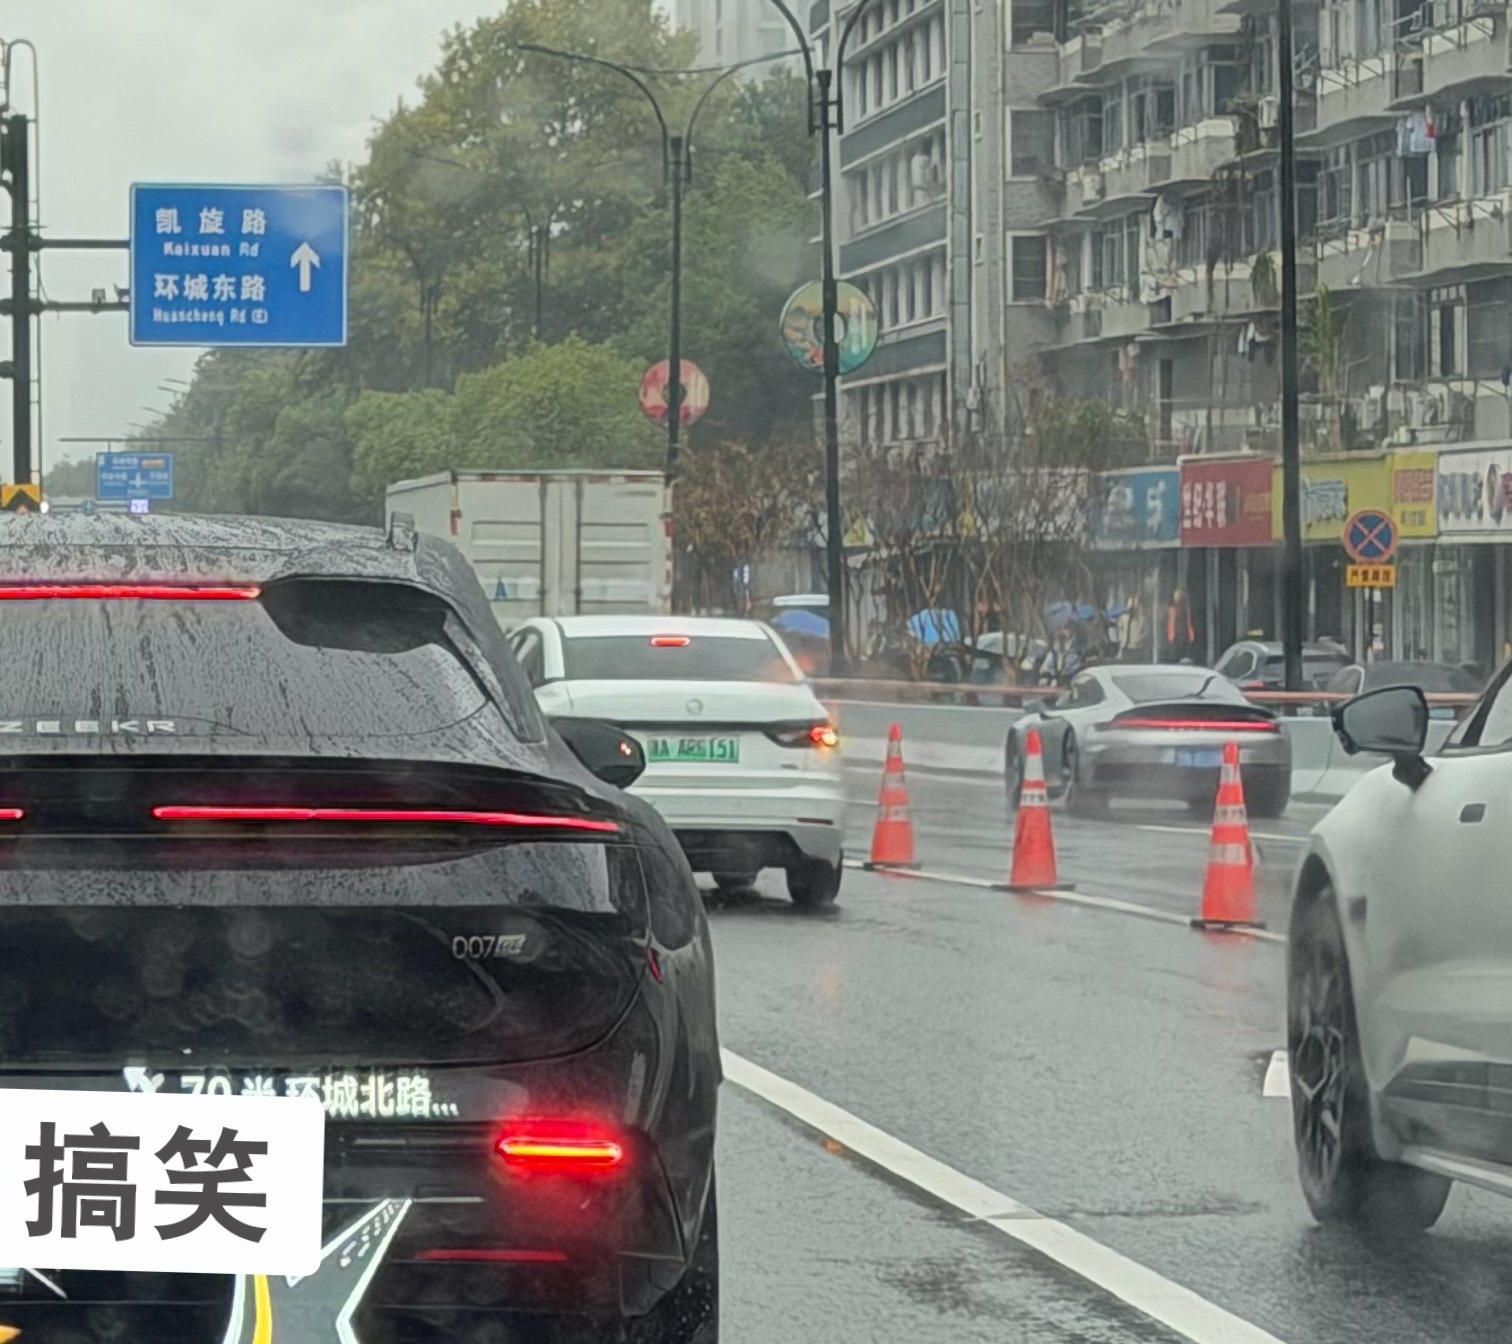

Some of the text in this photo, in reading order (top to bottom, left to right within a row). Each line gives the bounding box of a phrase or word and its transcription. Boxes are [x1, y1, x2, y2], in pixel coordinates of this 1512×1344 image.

[155, 207, 266, 235] 凯旋路
[163, 241, 260, 257] Kaixuan Rd
[153, 273, 266, 301] 环城东路
